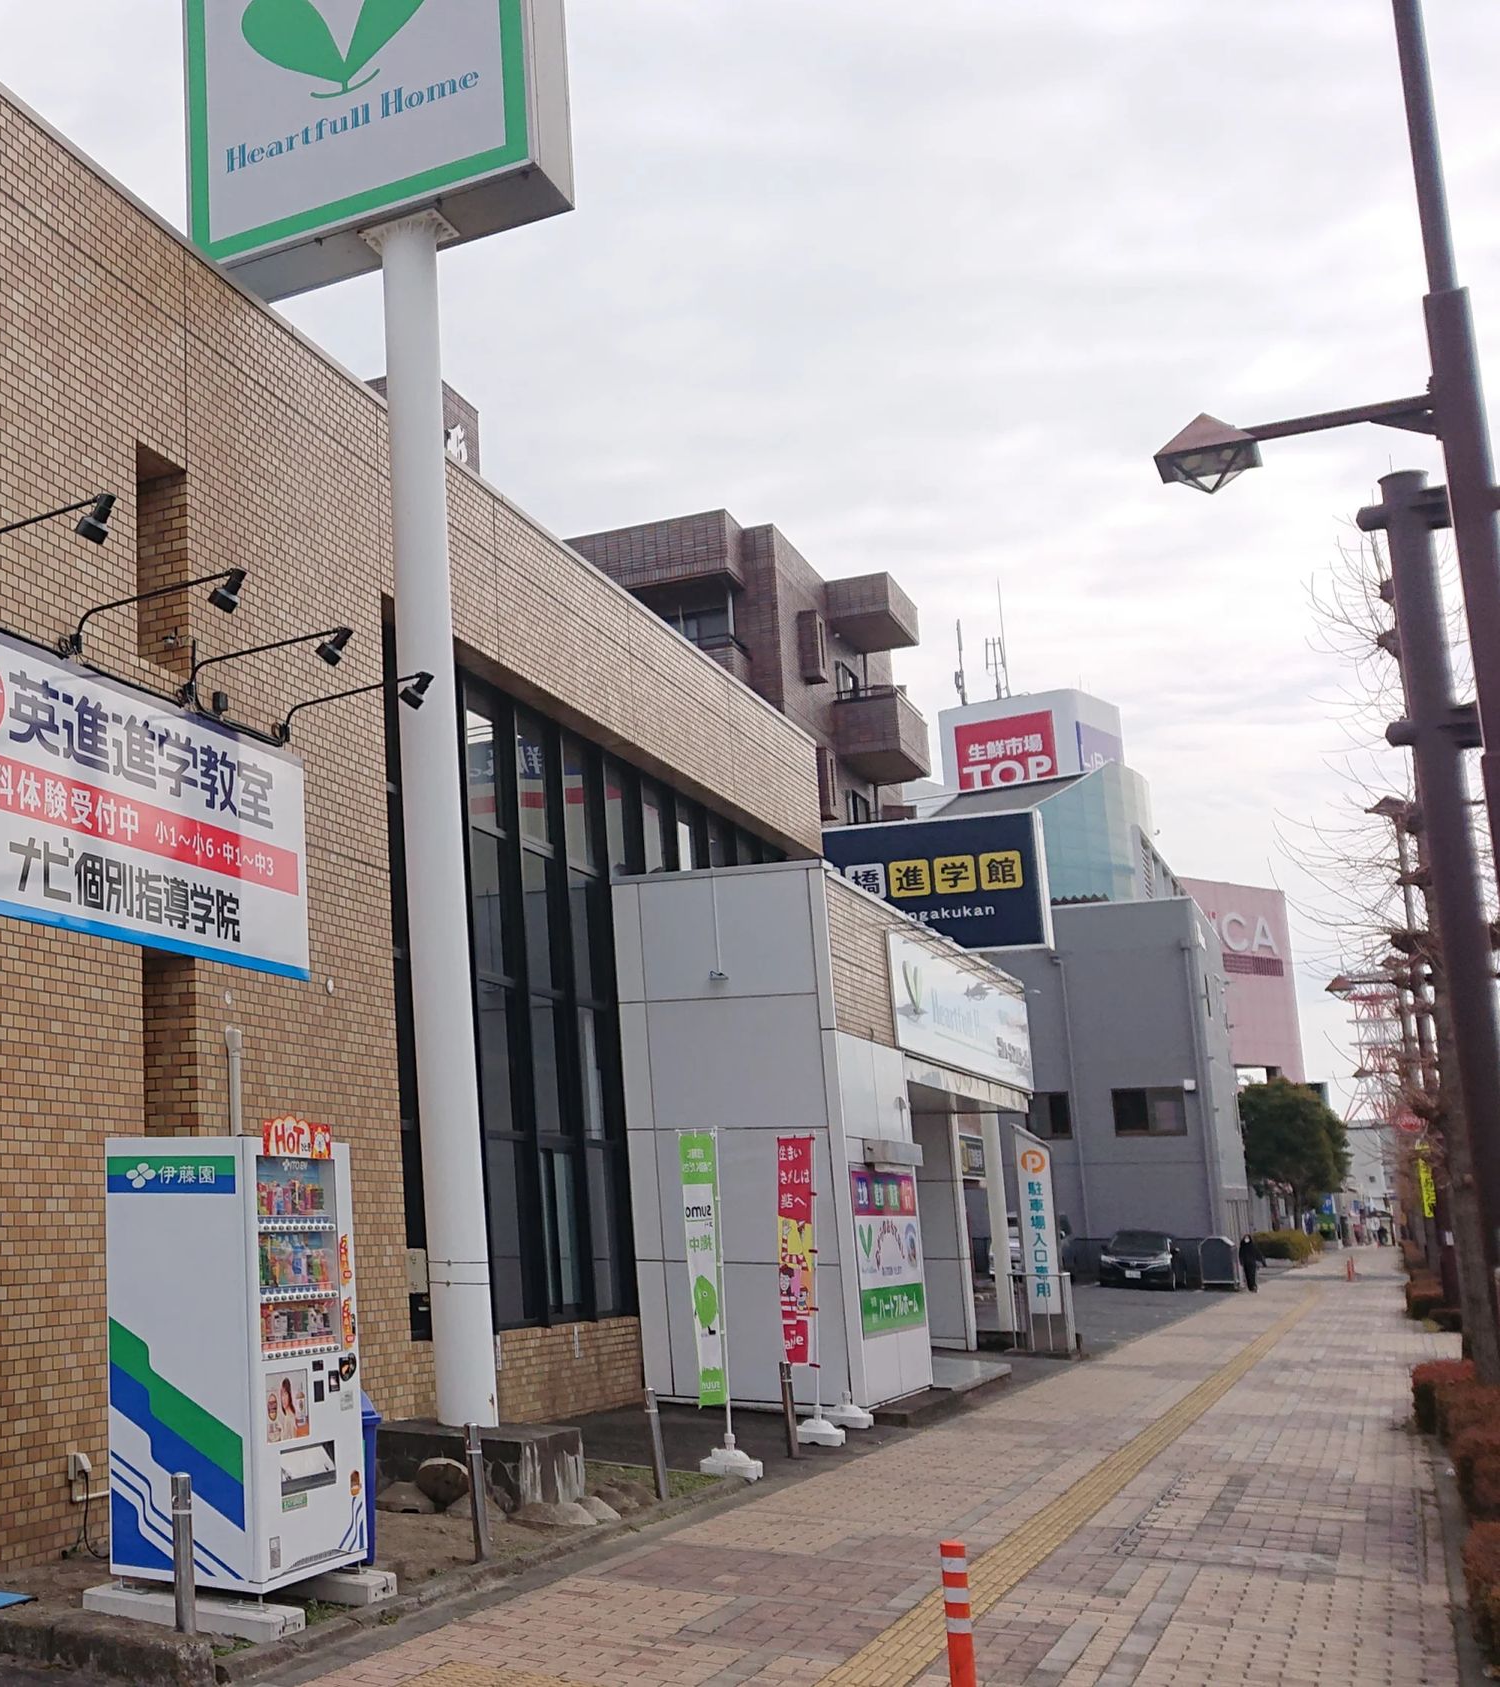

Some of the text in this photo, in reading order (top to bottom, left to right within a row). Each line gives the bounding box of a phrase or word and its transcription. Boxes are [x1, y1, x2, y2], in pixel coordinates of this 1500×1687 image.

[225, 71, 480, 173] Heartfull Home
[8, 670, 274, 829] 英進進学教室
[963, 755, 1052, 789] TOP
[968, 733, 1043, 762] 生鮮市場
[8, 837, 242, 943] ナビ個別指導学院
[274, 1123, 305, 1155] HOT
[158, 1165, 215, 1184] 伊藤園
[1027, 1181, 1052, 1298] 駐車場入口専用
